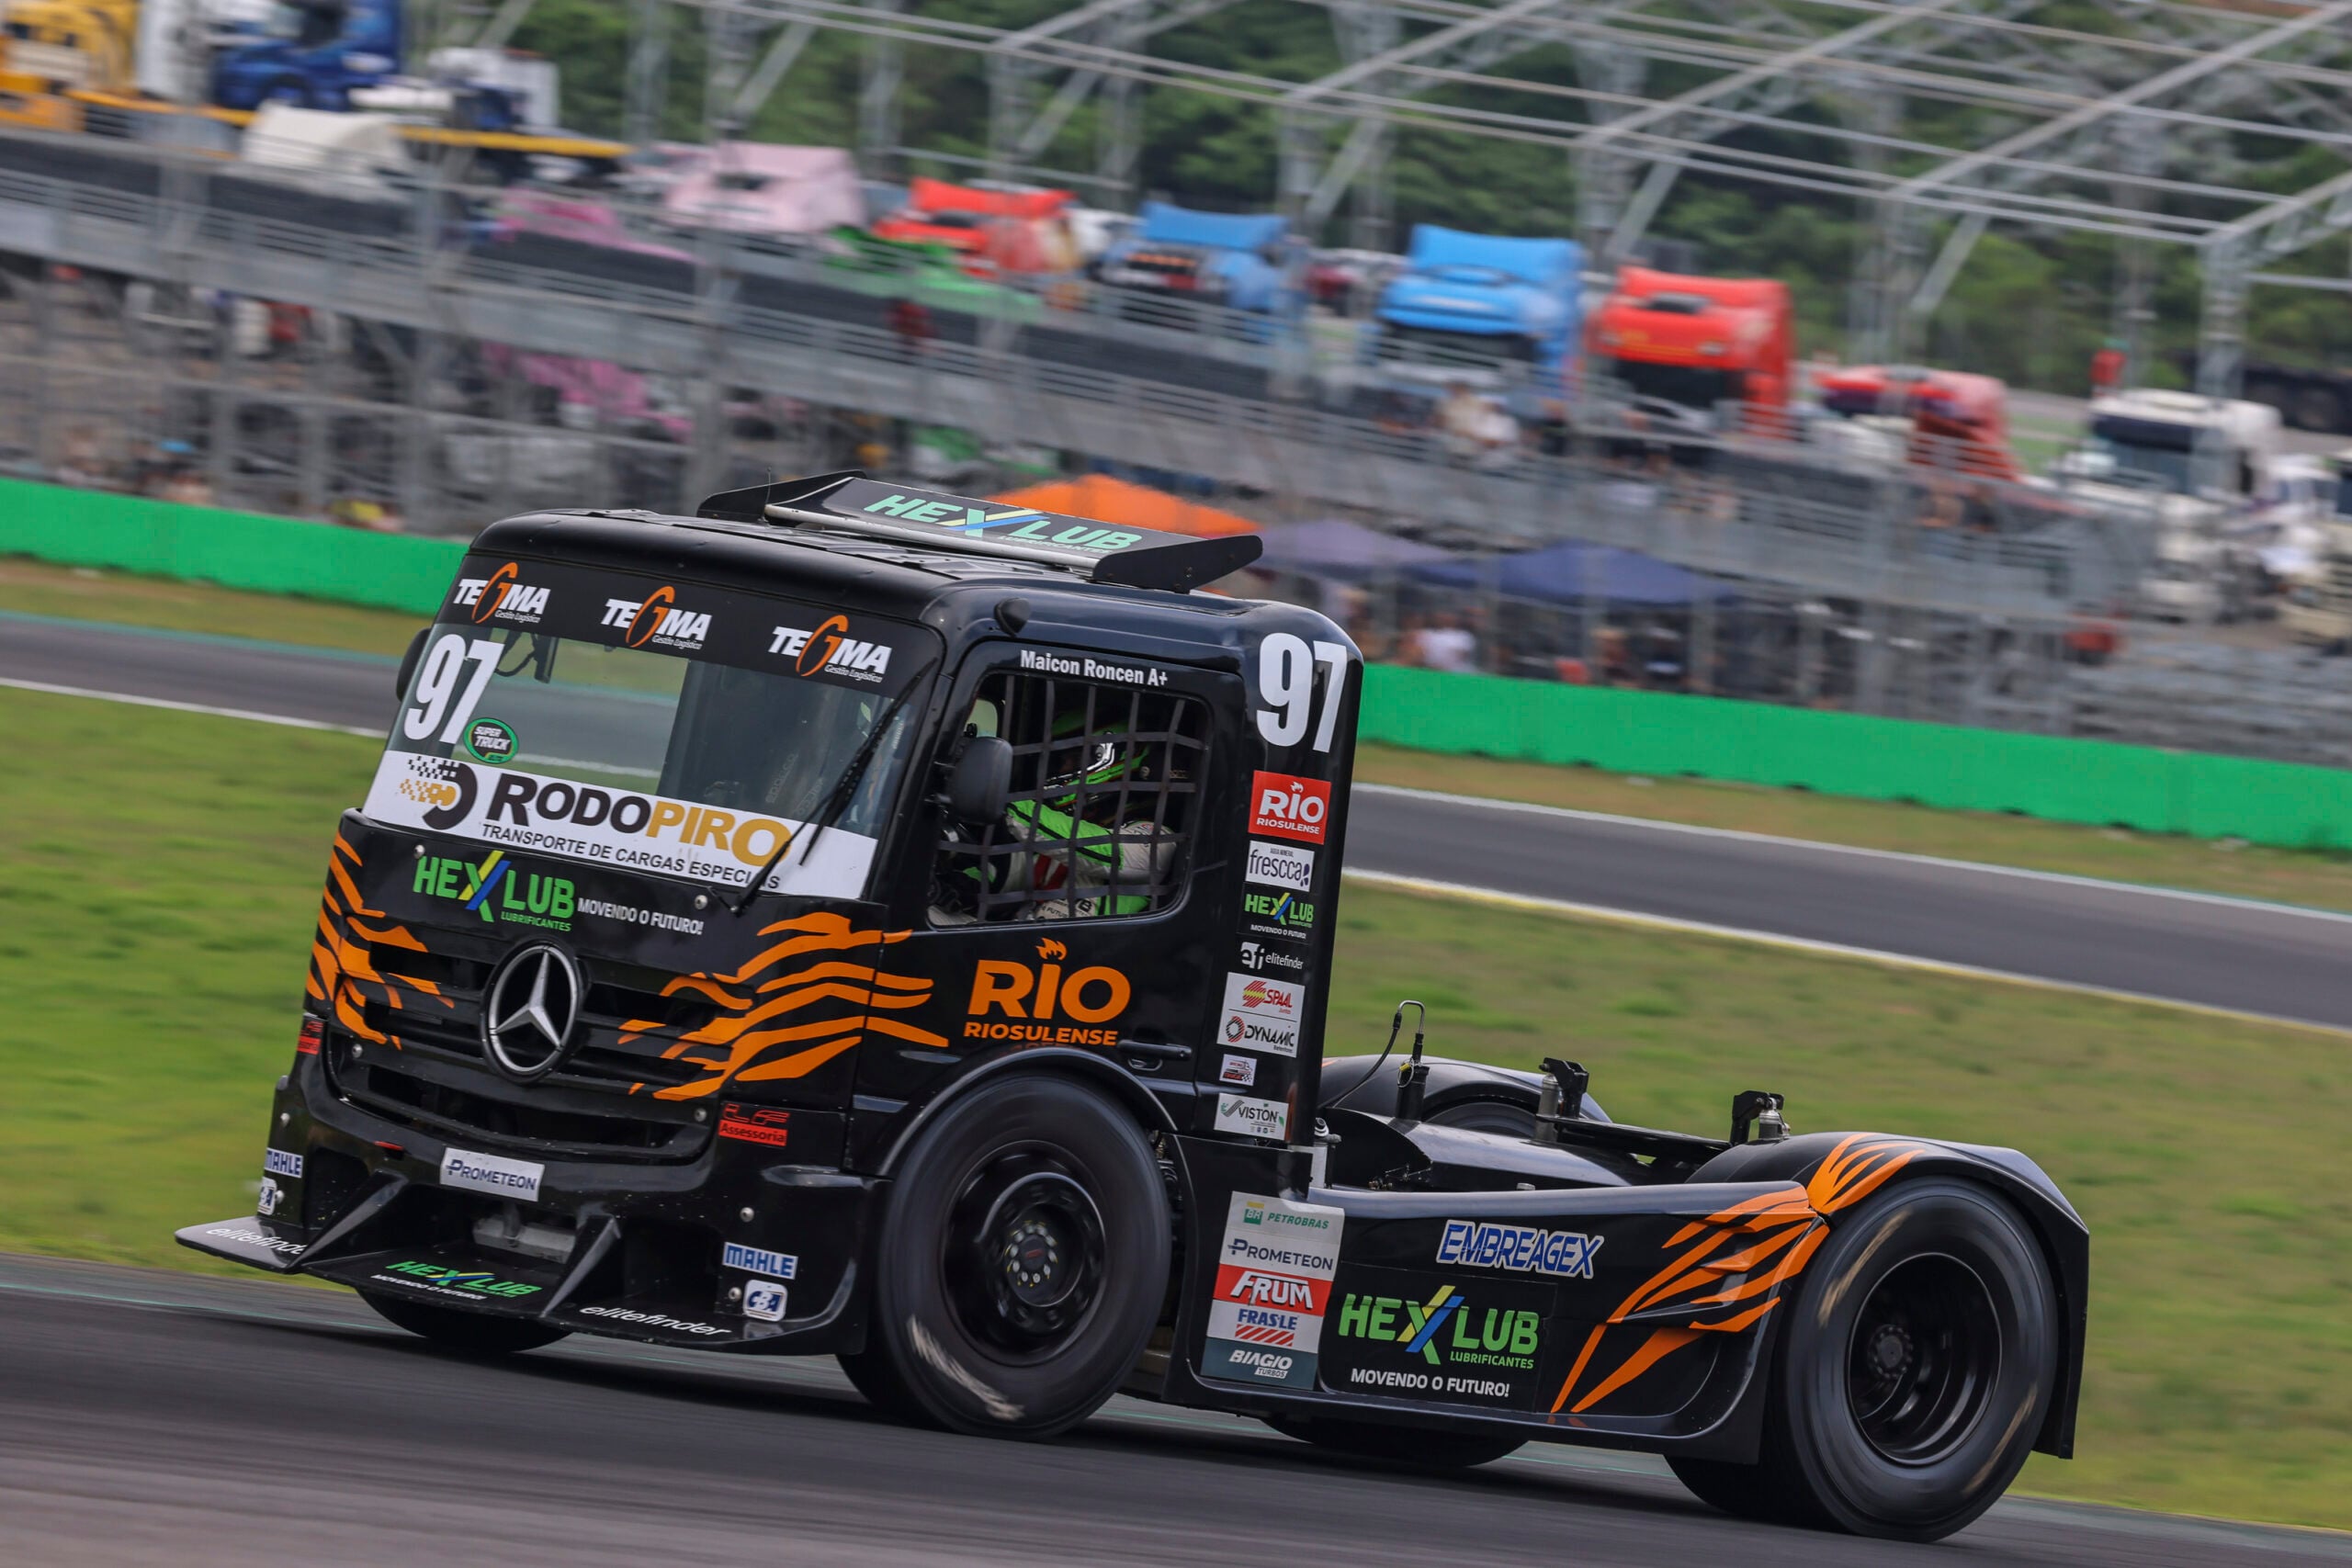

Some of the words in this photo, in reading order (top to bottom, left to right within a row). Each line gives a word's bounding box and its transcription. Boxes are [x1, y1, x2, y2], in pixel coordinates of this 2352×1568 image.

[453, 561, 551, 624] TEGMA
[600, 585, 712, 648] TEGMA
[768, 614, 892, 677] TEGMA
[1021, 649, 1080, 675] Maicon
[1084, 658, 1144, 684] Roncen
[1148, 668, 1168, 686] A+
[403, 634, 504, 744] 97
[1256, 632, 1348, 753] 97
[474, 735, 511, 750] TRUCK
[486, 773, 792, 867] RODOPIRO
[1259, 787, 1325, 823] RIO
[1256, 817, 1319, 834] RIOSULENSE
[482, 823, 587, 855] TRANSPORTE
[589, 843, 613, 859] DE
[616, 848, 685, 872] CARGAS
[689, 861, 780, 889] ESPECIS
[1250, 850, 1302, 881] frescca
[501, 911, 571, 932] LUBRIFICANTES
[577, 897, 637, 922] MOVENDO
[639, 909, 650, 924] O
[650, 912, 704, 935] FUTURO!
[1250, 924, 1283, 935] MOVENDO
[1265, 952, 1304, 969] elitefinder
[967, 959, 1131, 1023] RIO
[964, 1021, 1118, 1045] RIOSULENSE
[1238, 1107, 1278, 1122] VISTON
[721, 1122, 785, 1142] Assessoria
[446, 1159, 537, 1190] PROMETEON
[1268, 1213, 1329, 1229] PETROBRAS
[726, 1245, 794, 1277] MAHLE
[1227, 1238, 1333, 1270] PROMETEON
[1438, 1224, 1602, 1277] EMBREAGEX
[748, 1291, 781, 1312] CBA
[1230, 1270, 1313, 1309] FRUM
[579, 1304, 731, 1336] elitefinder
[1229, 1349, 1293, 1370] BIAGIO
[1258, 1368, 1285, 1377] TURBOS
[1450, 1351, 1534, 1370] LUBRIFICANTES
[1351, 1368, 1428, 1389] MOVENDO
[1431, 1376, 1443, 1390] O
[1447, 1378, 1510, 1397] FUTURO!
